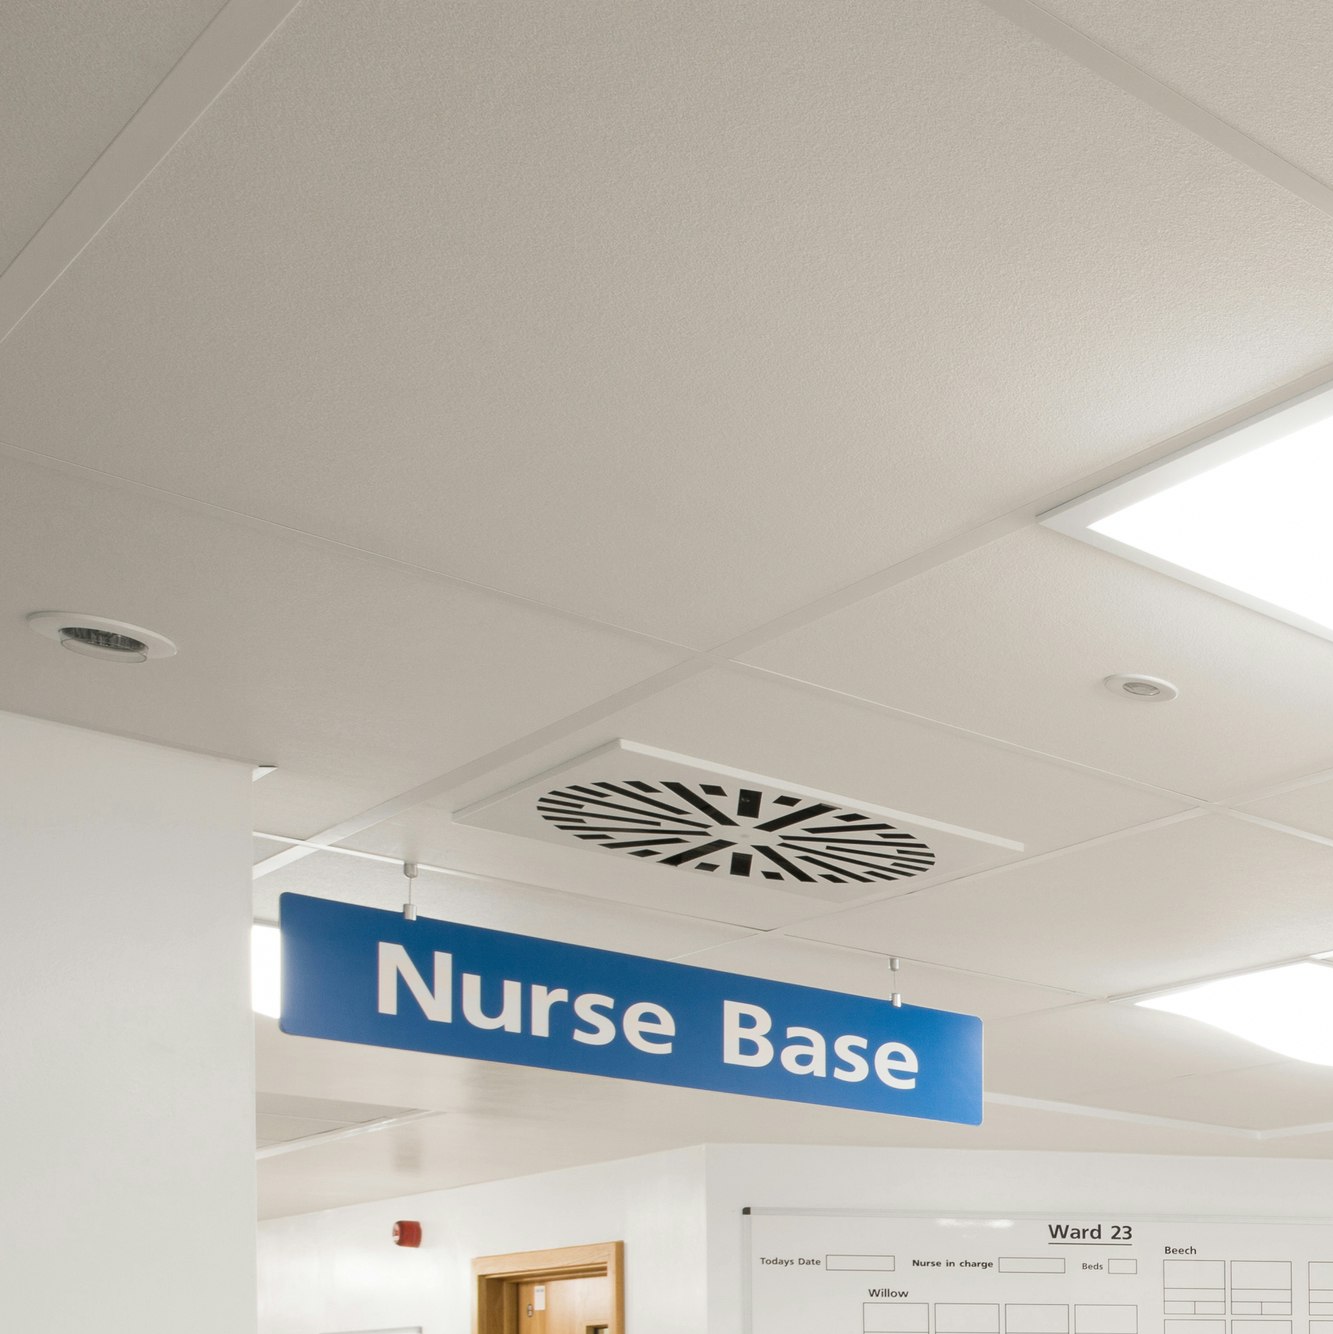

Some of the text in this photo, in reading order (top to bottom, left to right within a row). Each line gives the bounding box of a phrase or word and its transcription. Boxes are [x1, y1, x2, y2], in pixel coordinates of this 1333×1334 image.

[377, 940, 919, 1090] Nurse Base
[1047, 1223, 1133, 1241] Ward 23
[1164, 1245, 1197, 1255] Beech
[759, 1256, 822, 1268] Todays Date
[912, 1259, 994, 1270] Nurse in charge
[1081, 1262, 1104, 1271] Beds
[867, 1288, 909, 1298] Willow
